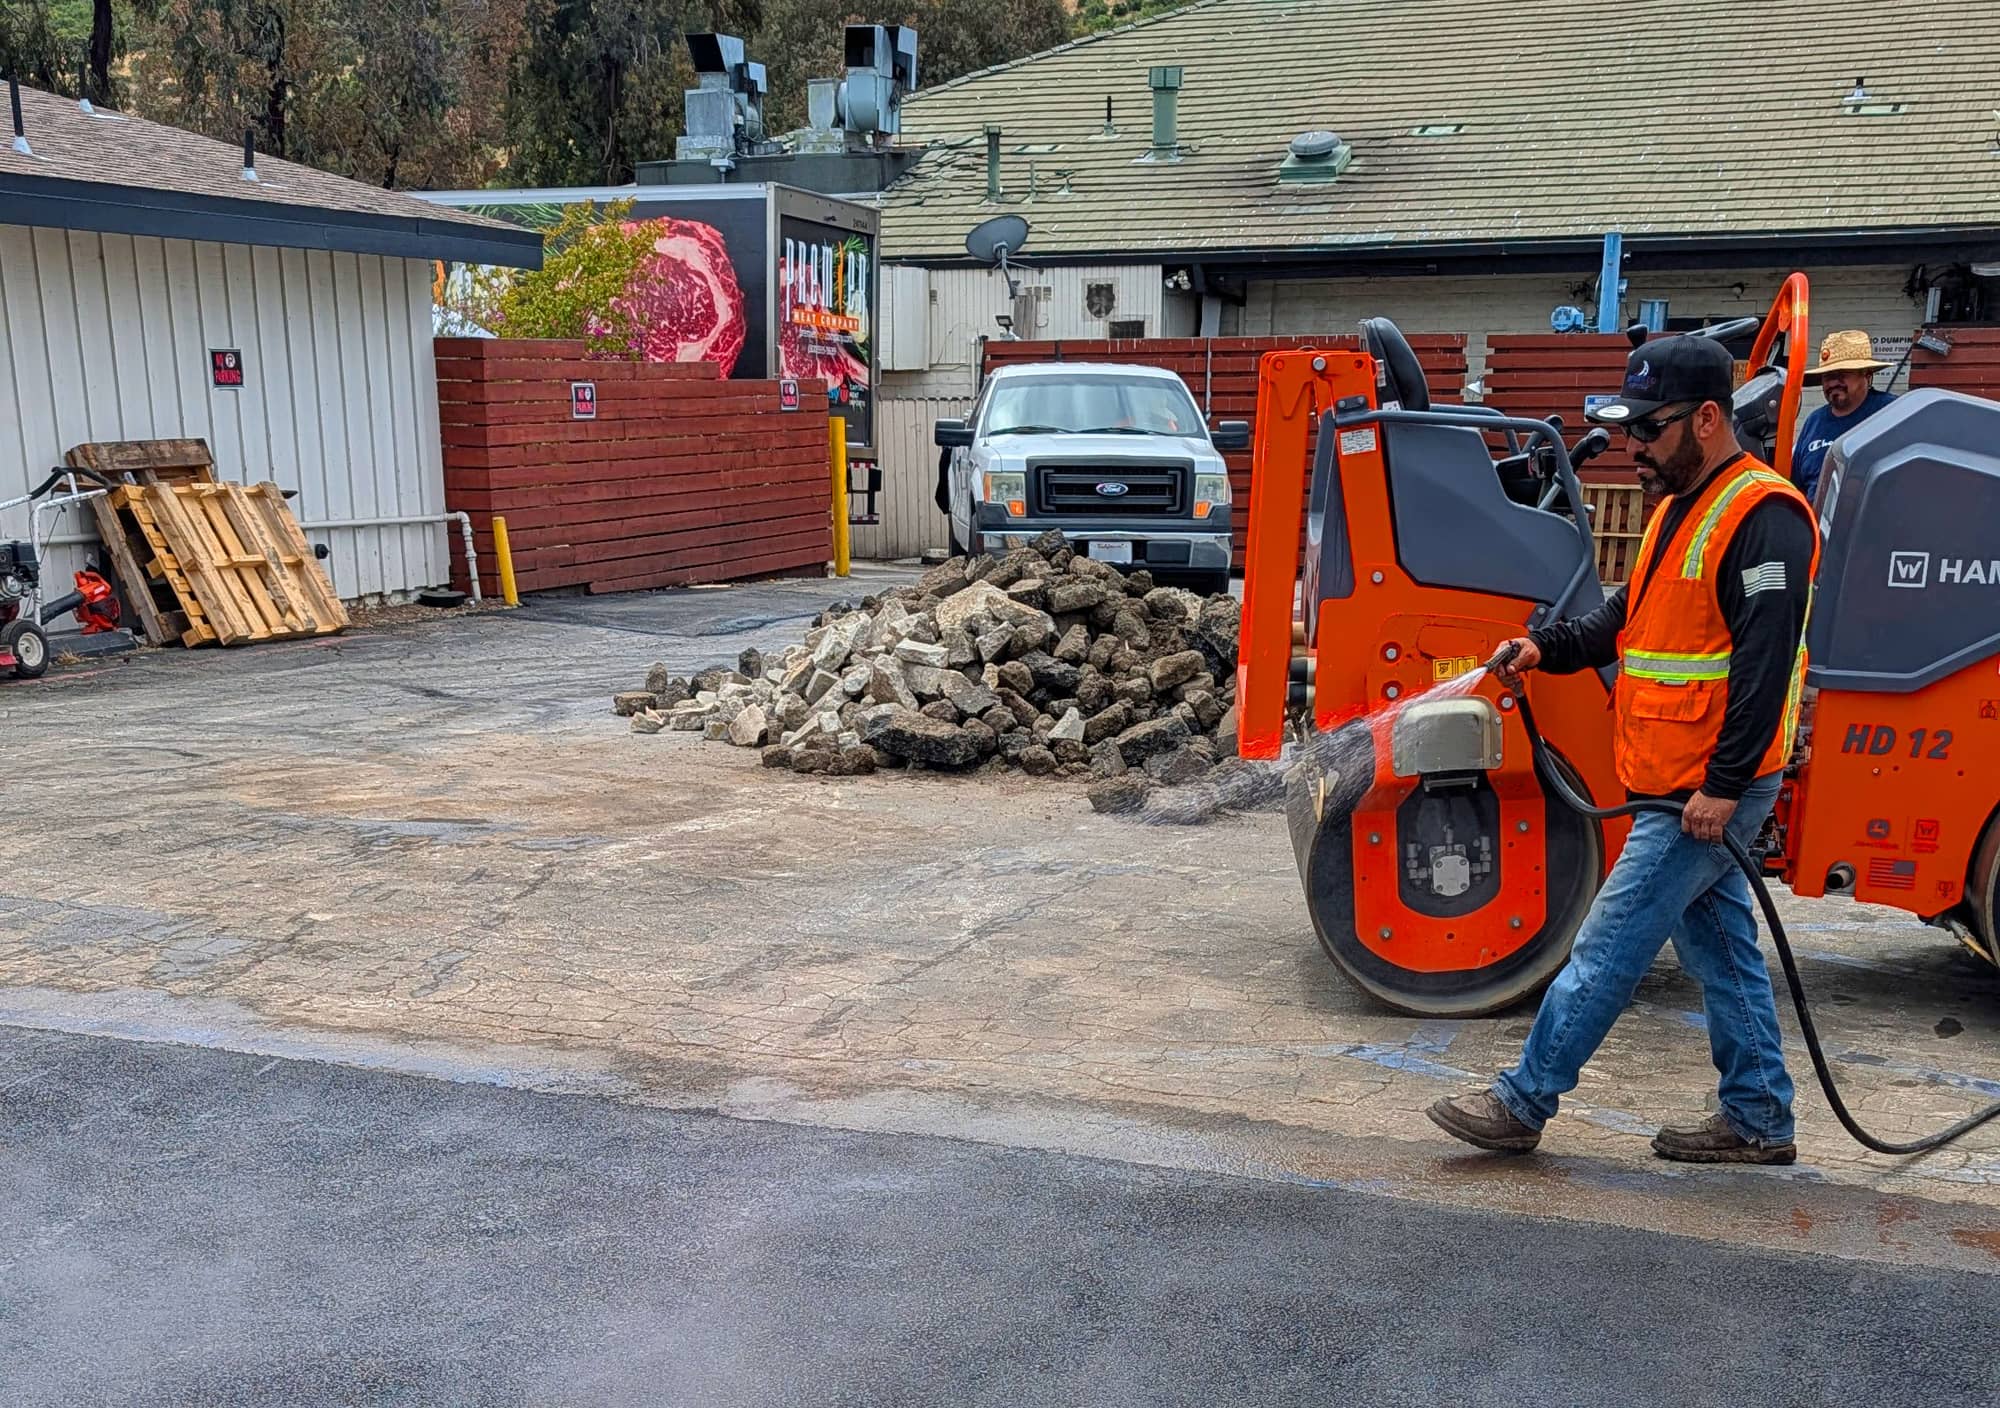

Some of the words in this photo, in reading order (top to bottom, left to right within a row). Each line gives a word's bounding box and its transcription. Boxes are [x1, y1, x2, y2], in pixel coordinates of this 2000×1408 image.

[793, 310, 816, 324] MEAT
[820, 314, 858, 331] COMPANY
[215, 368, 241, 384] PARKING
[1841, 723, 1897, 755] HD
[1910, 728, 1953, 760] 12
